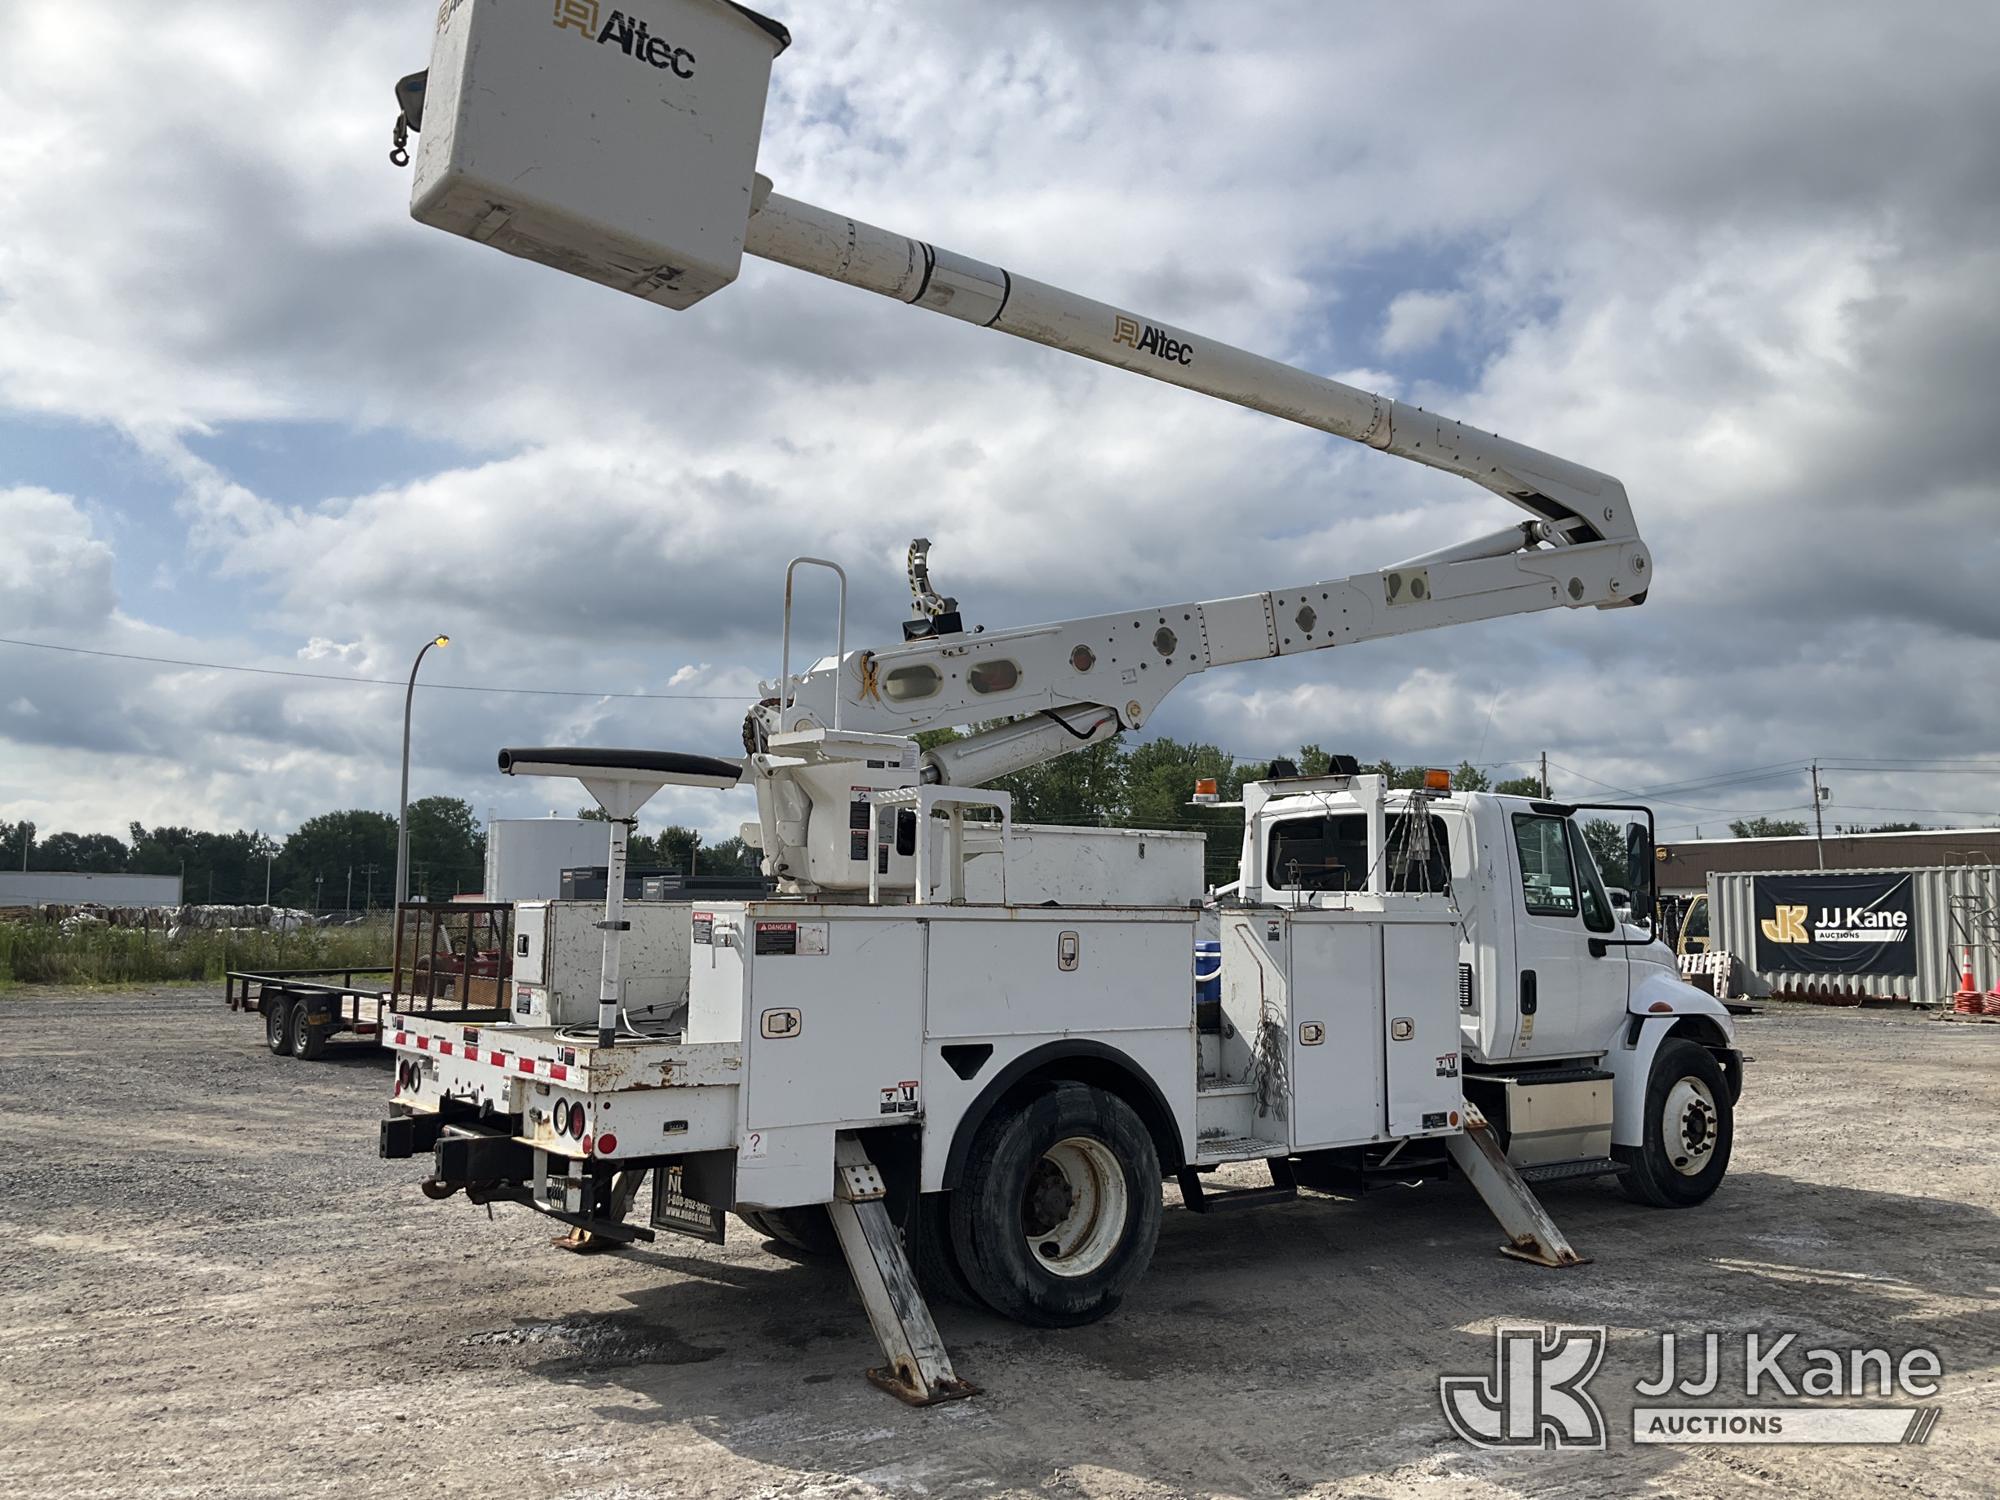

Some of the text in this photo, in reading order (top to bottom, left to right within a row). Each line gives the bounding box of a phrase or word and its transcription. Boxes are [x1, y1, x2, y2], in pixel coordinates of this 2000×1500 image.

[597, 10, 695, 79] Altec
[1136, 325, 1193, 366] Altec
[1815, 907, 1908, 928] JJ Kane
